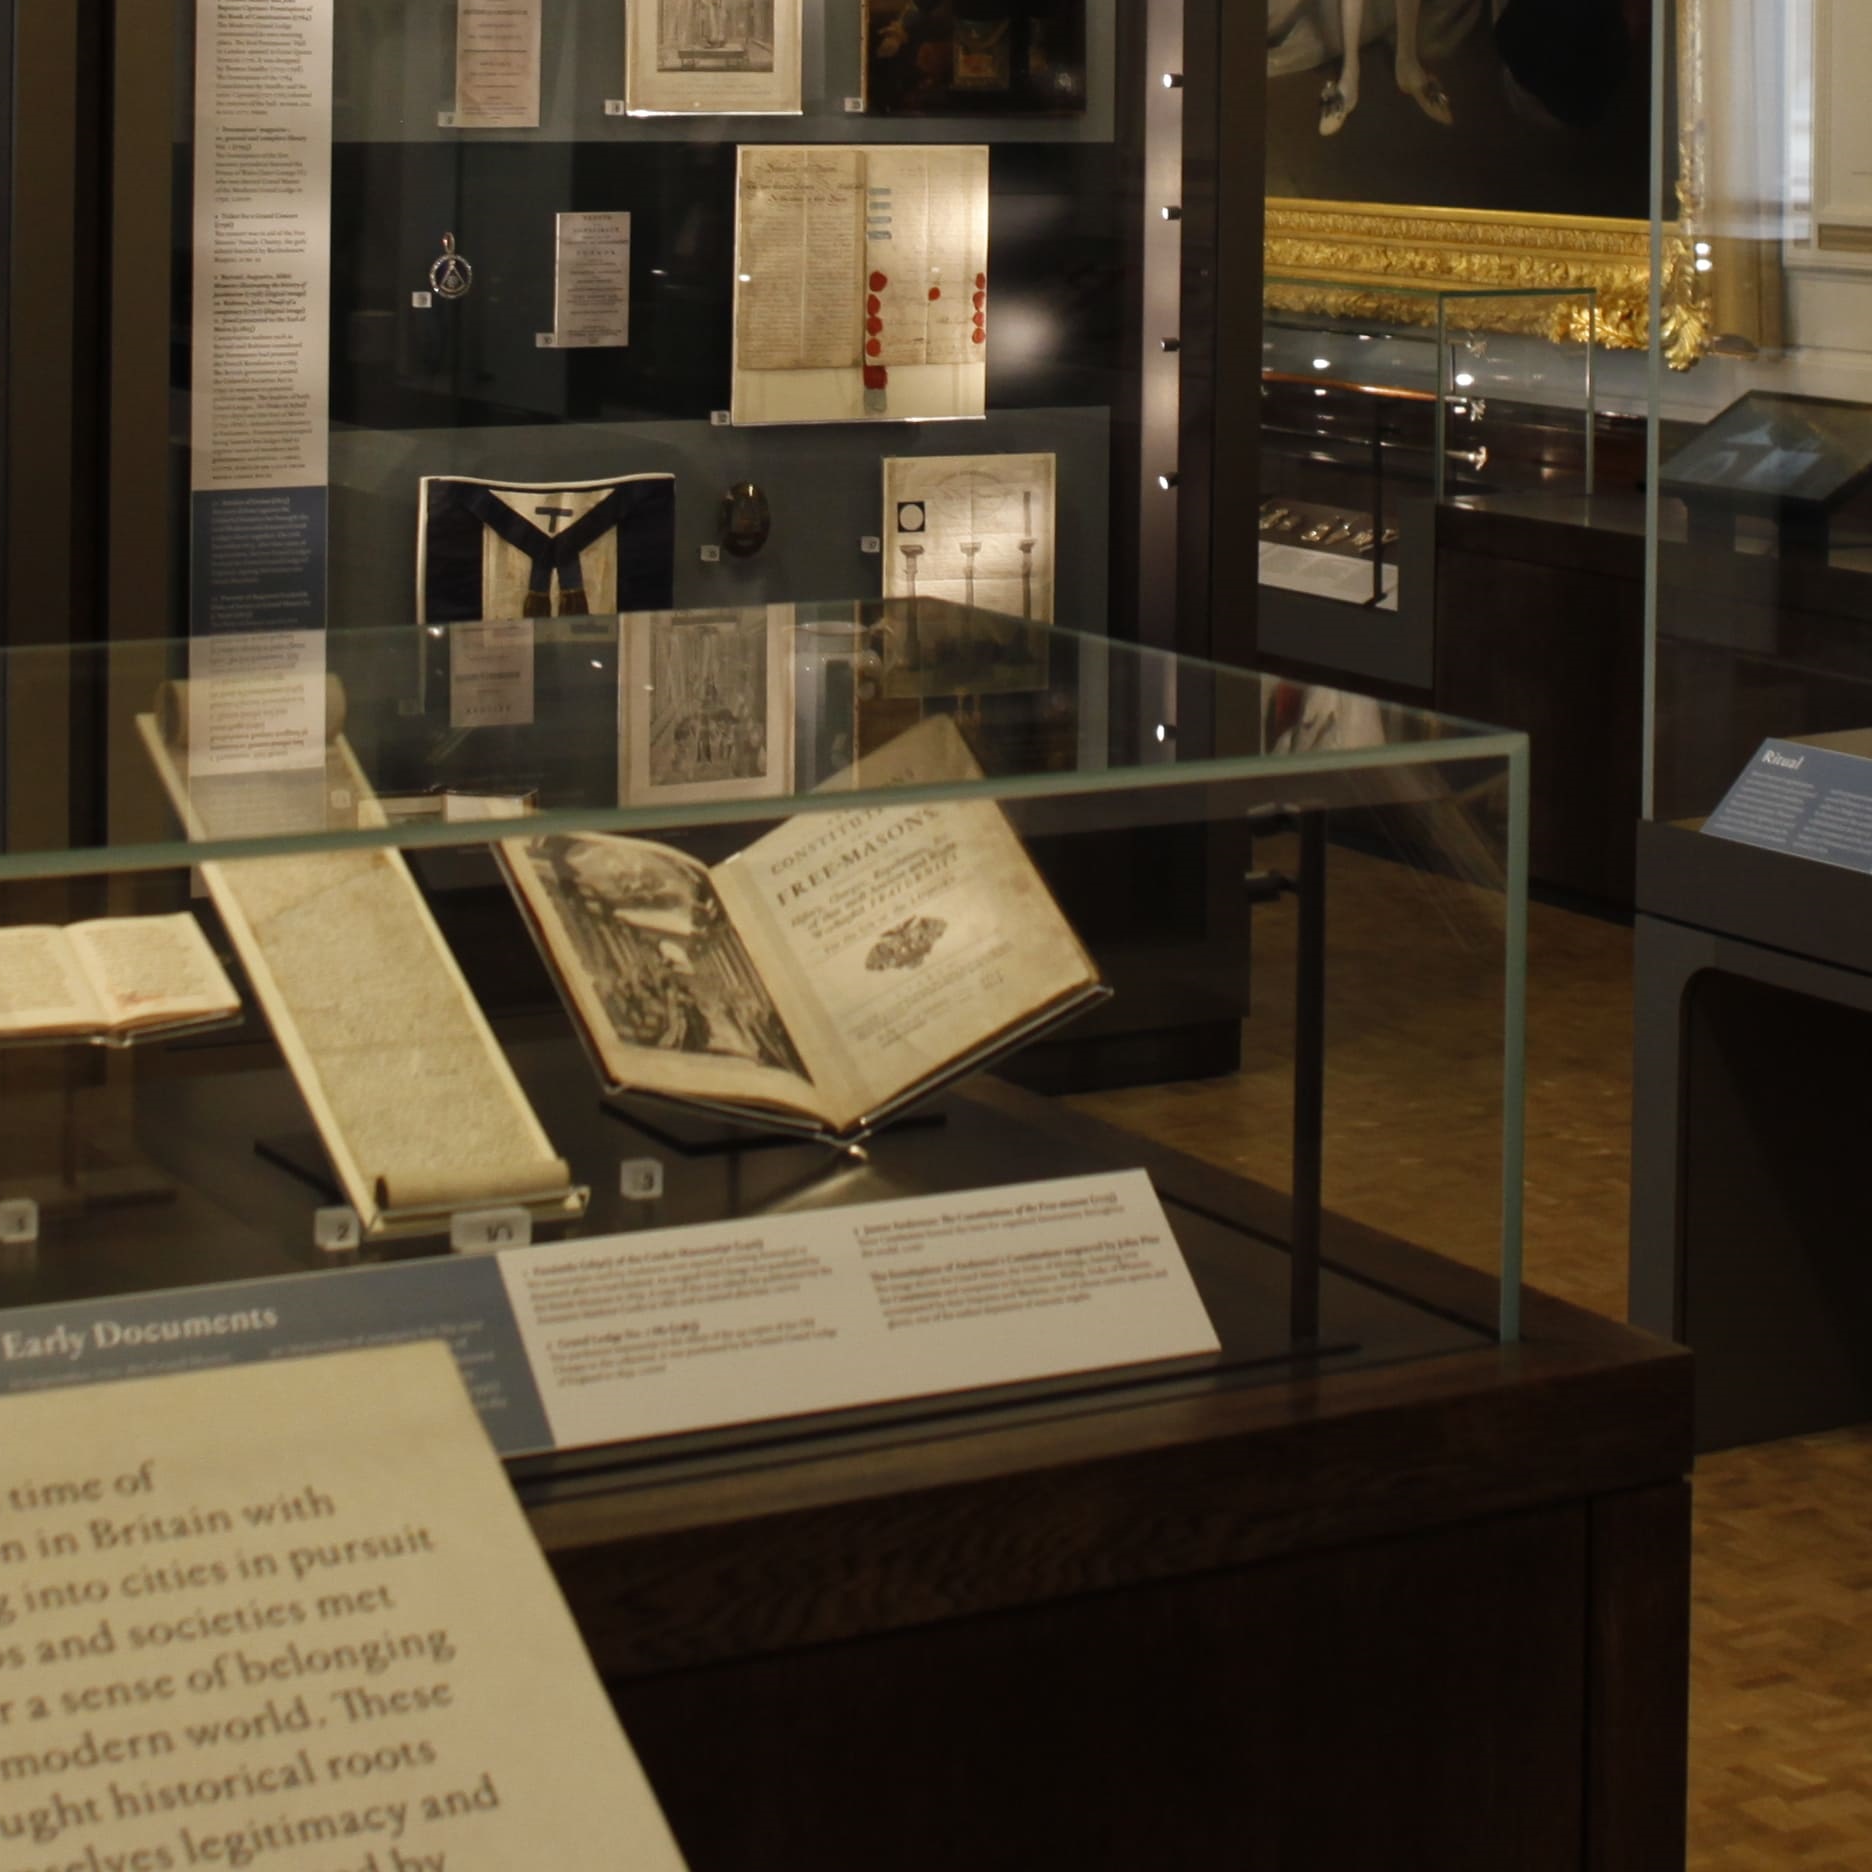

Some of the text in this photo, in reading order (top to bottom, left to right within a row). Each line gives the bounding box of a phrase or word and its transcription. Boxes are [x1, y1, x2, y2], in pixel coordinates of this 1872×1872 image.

[1761, 749, 1805, 770] Ritual
[643, 1172, 656, 1190] 3
[336, 1222, 351, 1241] 2
[0, 1308, 280, 1361] Early Documents
[8, 1473, 103, 1511] time
[114, 1459, 155, 1496] of
[38, 1529, 79, 1558] in
[89, 1507, 234, 1553] Britain
[242, 1486, 336, 1527] with
[24, 1572, 109, 1614] into
[120, 1554, 228, 1600] cities
[236, 1543, 278, 1578] in
[291, 1526, 435, 1582] pursuit
[35, 1621, 117, 1665] and
[130, 1596, 307, 1650] societies
[317, 1584, 396, 1619] met
[28, 1694, 51, 1721] a
[61, 1672, 175, 1713] sense
[187, 1658, 230, 1695] of
[236, 1628, 457, 1687] belonging
[0, 1728, 176, 1782] modern
[185, 1696, 328, 1748] world.
[332, 1680, 454, 1724] These
[110, 1750, 317, 1820] historical
[328, 1737, 438, 1781] roots
[180, 1802, 408, 1867] legitimacy
[424, 1771, 501, 1821] and
